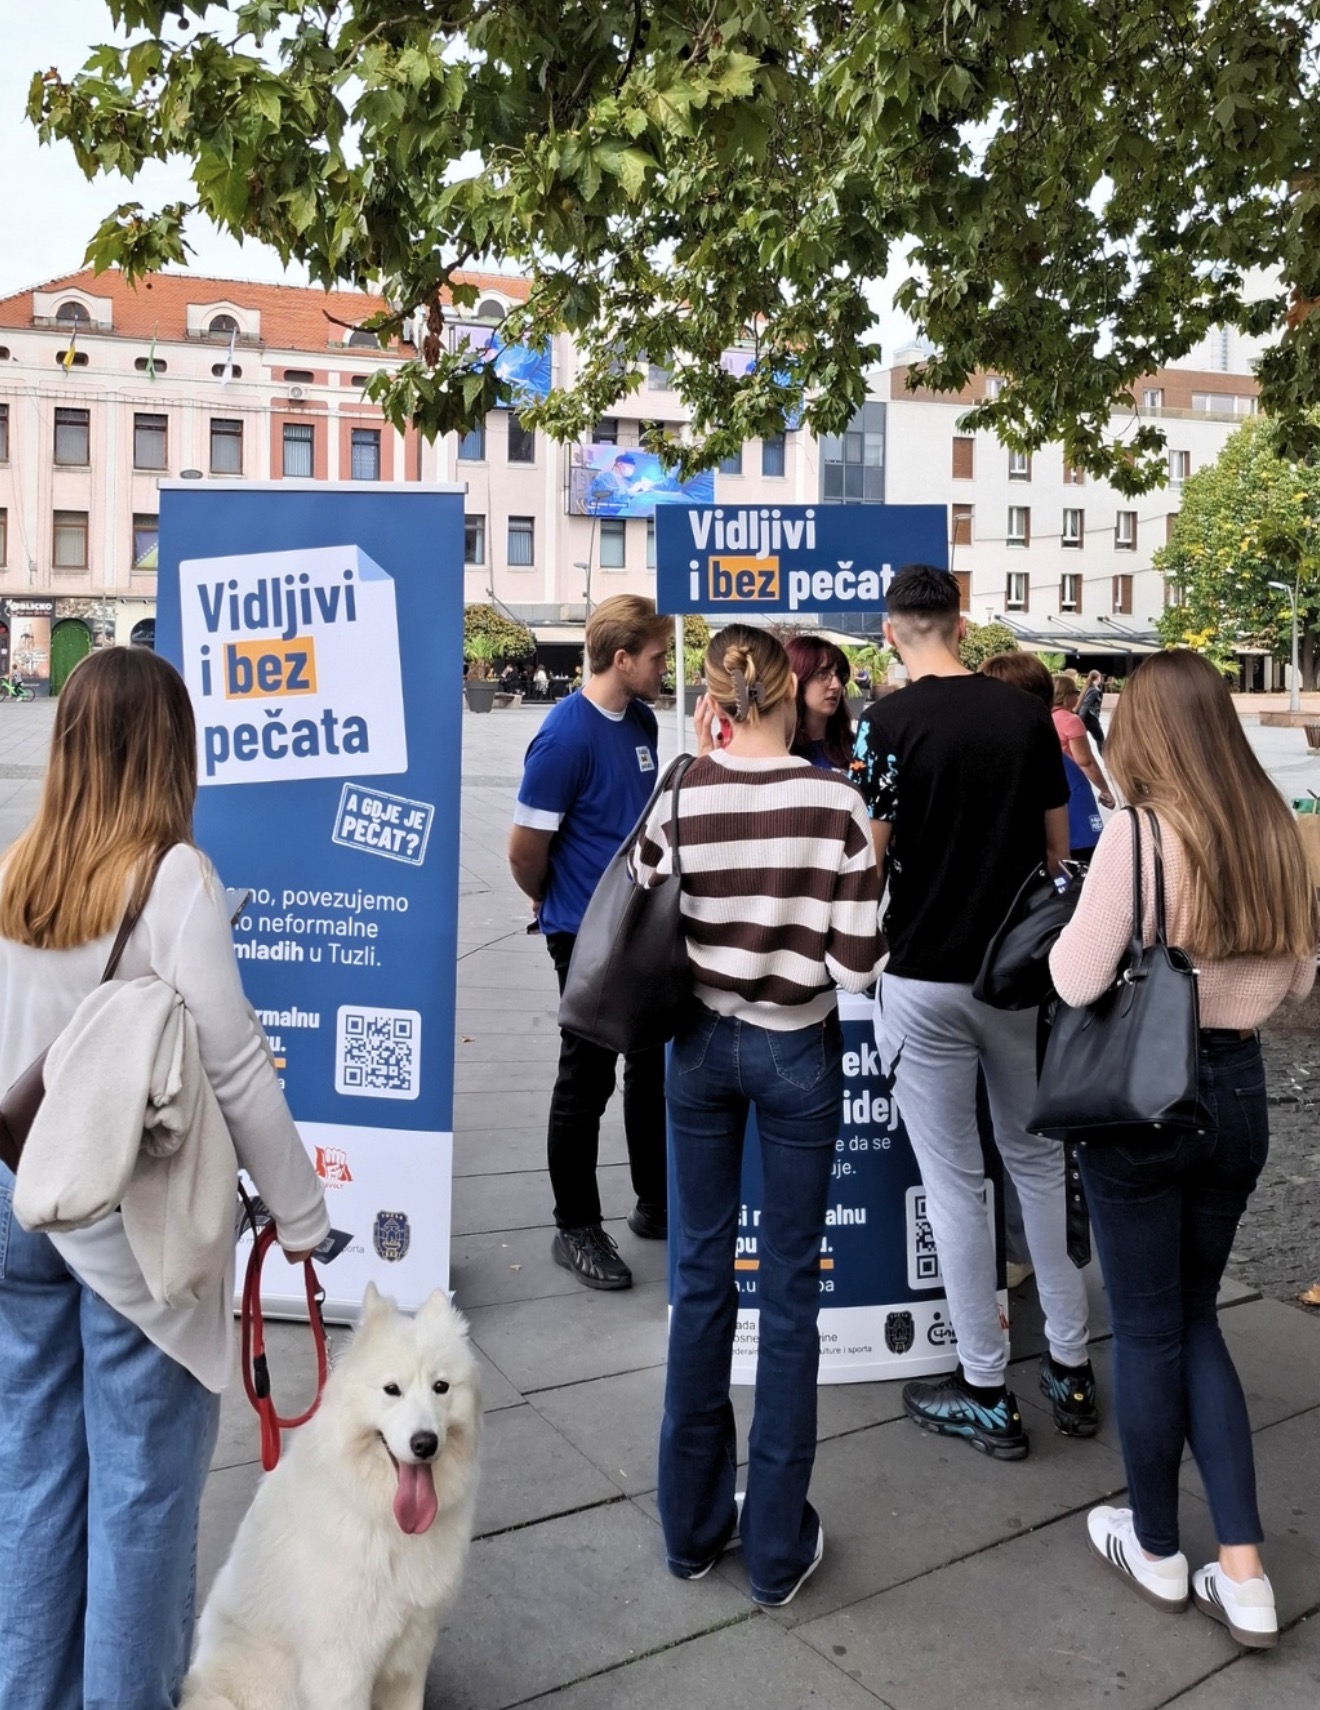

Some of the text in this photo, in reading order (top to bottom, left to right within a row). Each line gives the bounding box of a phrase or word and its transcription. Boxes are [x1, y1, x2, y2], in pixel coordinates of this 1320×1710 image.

[688, 509, 816, 560] Vidljivi
[689, 560, 895, 611] i bez pečat
[197, 569, 357, 641] Vidljivi
[200, 643, 310, 697] i bez
[204, 708, 370, 776] pečata
[346, 793, 426, 830] A GDJE JE
[341, 815, 420, 855] PEČAT?
[282, 889, 409, 914] povezujemo
[259, 913, 379, 938] neformalne
[233, 939, 382, 967] mladih u Tuzli.
[254, 1006, 320, 1028] rmalnu
[843, 1089, 899, 1131] idej
[849, 1135, 868, 1151] da
[872, 1137, 891, 1150] se
[733, 1334, 760, 1343] osne
